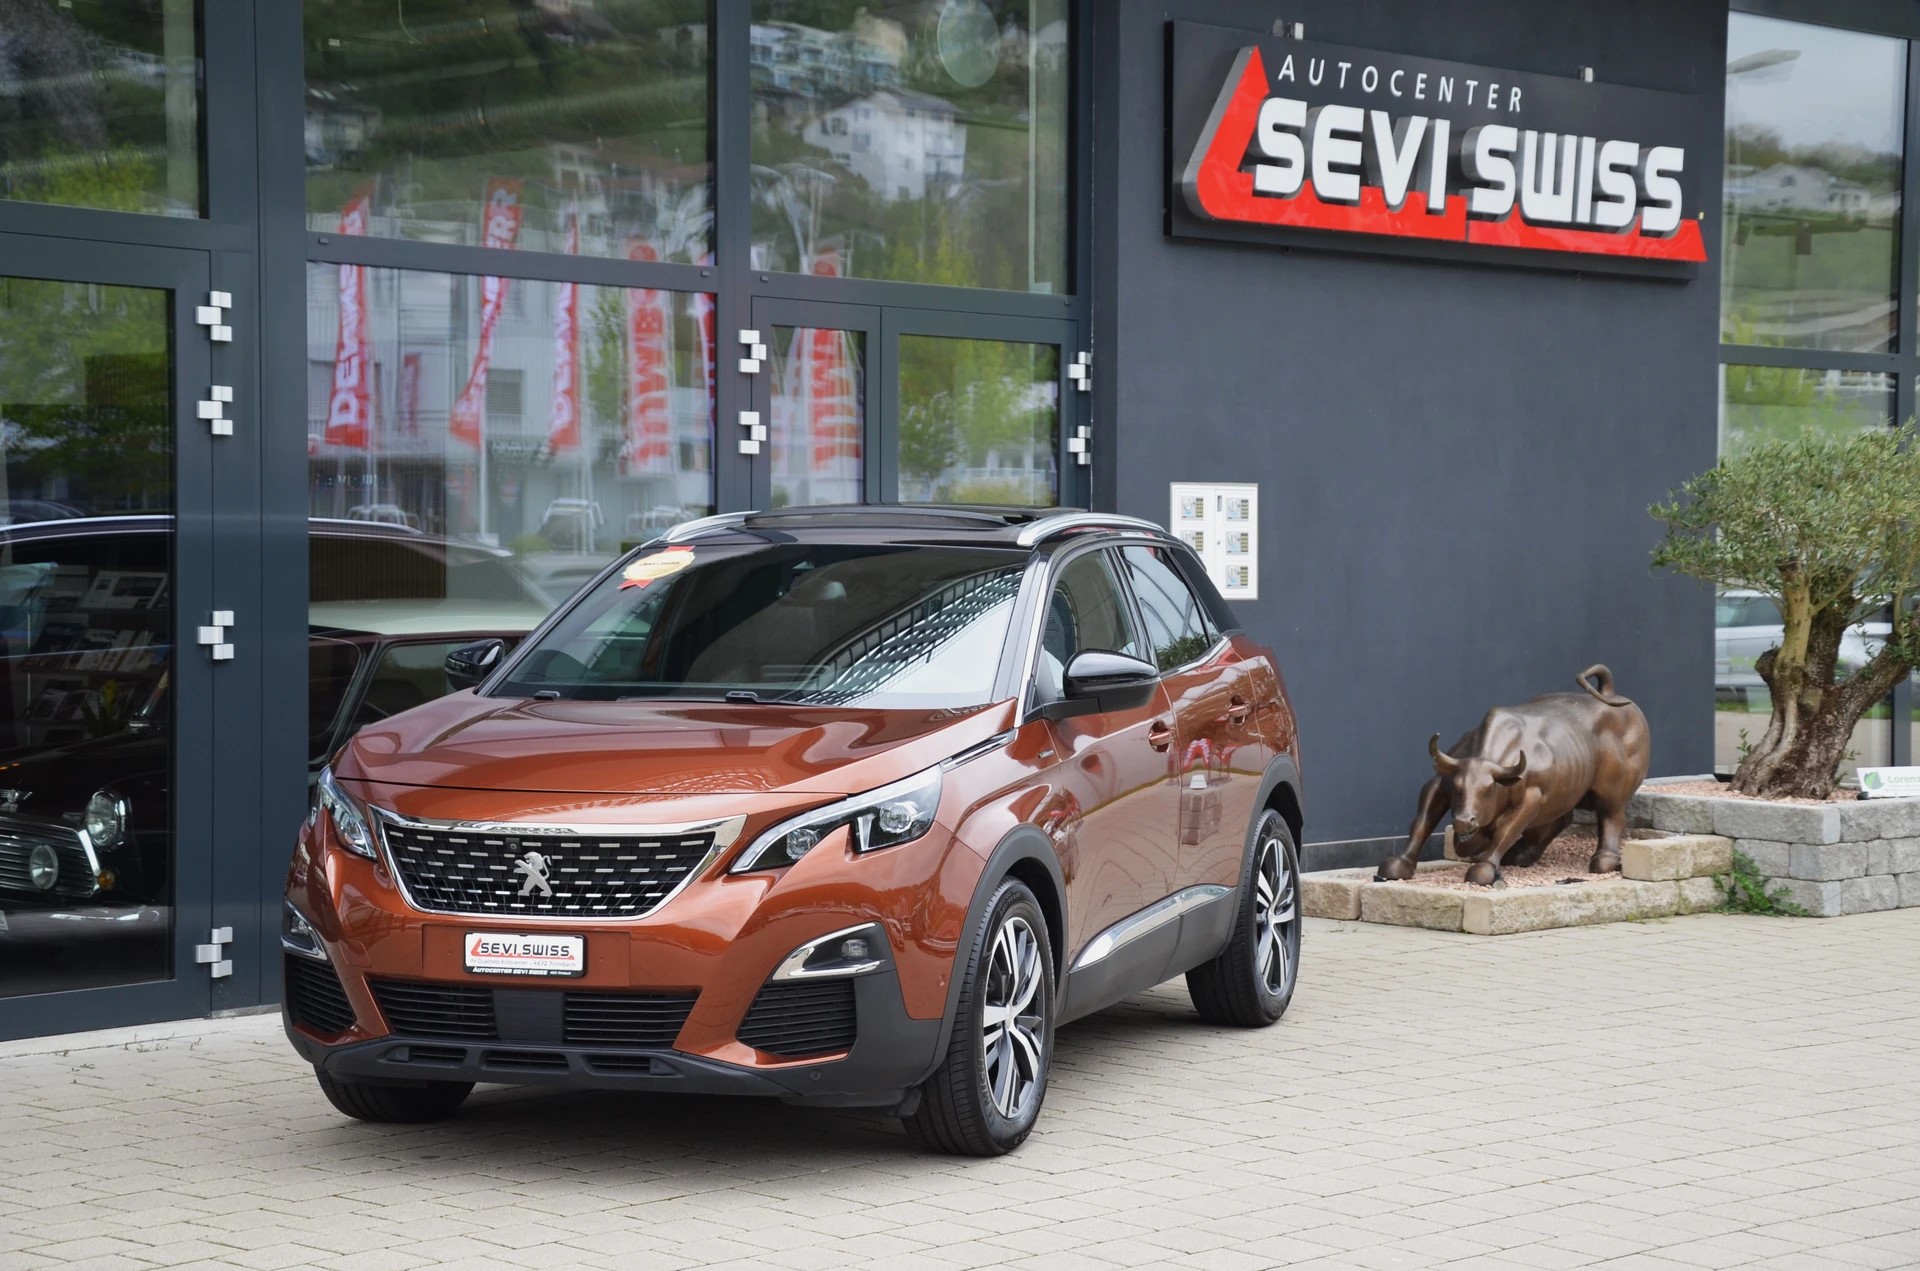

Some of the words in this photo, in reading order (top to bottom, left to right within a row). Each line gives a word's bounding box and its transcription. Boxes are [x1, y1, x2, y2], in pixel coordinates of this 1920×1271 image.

[1278, 54, 1524, 113] AUTOCENTER
[1249, 97, 1451, 214] SEVI
[1468, 124, 1685, 235] SWISS
[480, 943, 517, 955] SEVI
[522, 944, 570, 956] SWISS
